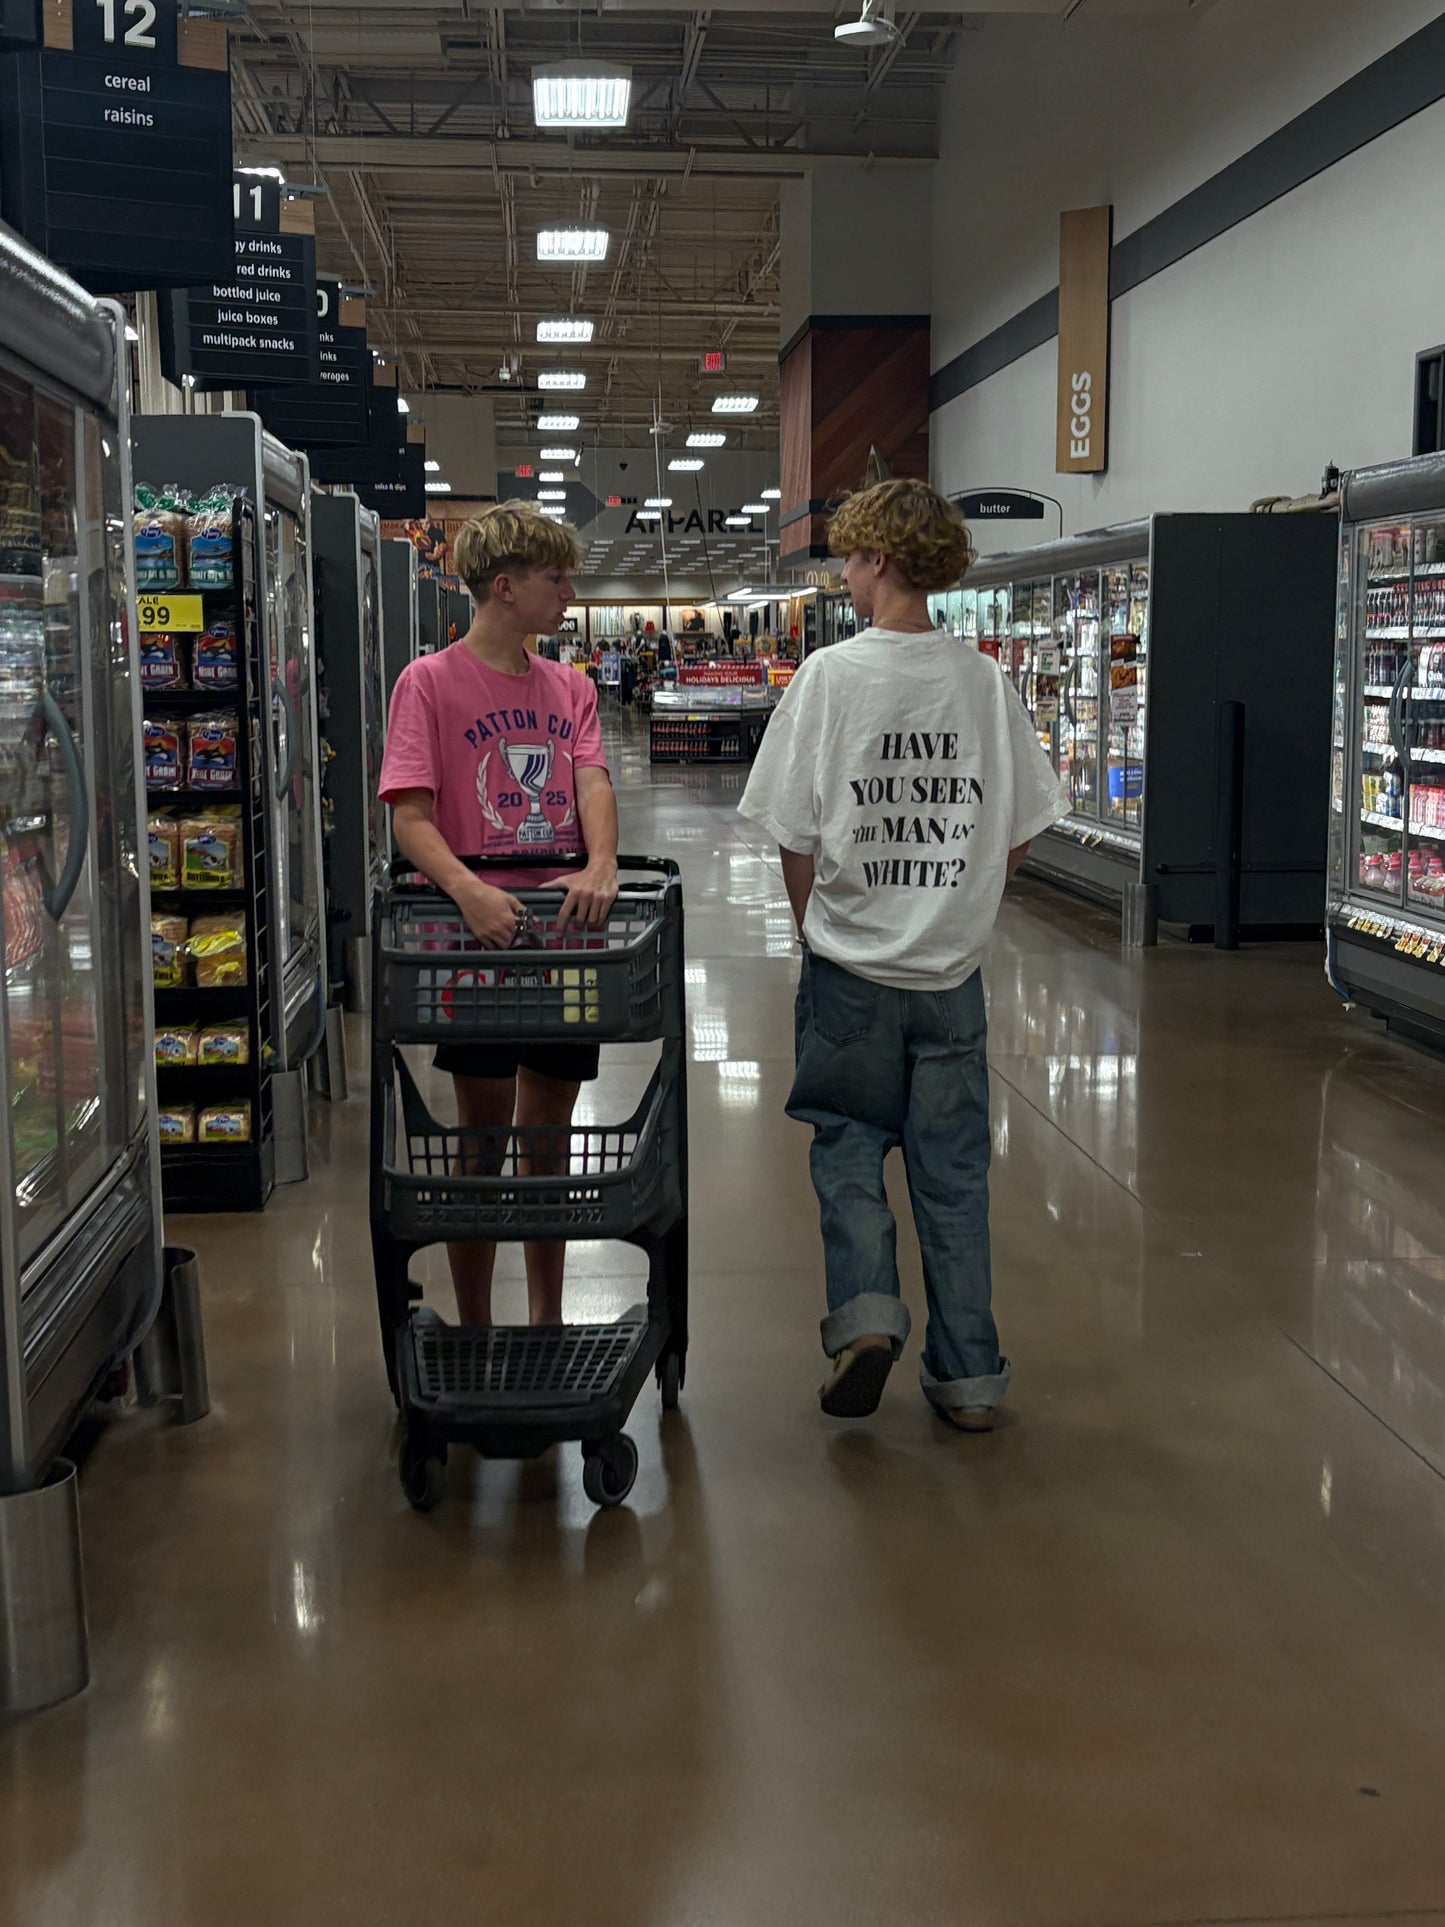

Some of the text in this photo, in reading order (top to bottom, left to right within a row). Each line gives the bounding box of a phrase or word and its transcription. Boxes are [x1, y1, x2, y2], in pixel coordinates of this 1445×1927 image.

[96, 0, 156, 48] 12
[104, 75, 151, 93] cereal
[104, 106, 154, 127] raisins
[233, 183, 262, 221] 11
[248, 240, 282, 254] drinks
[257, 264, 291, 279] drinks
[213, 285, 281, 303] bottled juice
[218, 308, 279, 326] juice boxes
[203, 332, 295, 350] multipack snacks
[1070, 371, 1092, 459] EGGS
[980, 503, 1011, 514] butter
[685, 675, 756, 684] HOLIDAYS DELICIOUS
[464, 709, 573, 749] PATTON CU
[880, 733, 958, 760] HAVE
[498, 790, 567, 808] 20 25
[849, 776, 985, 806] YOU SEEN
[852, 816, 975, 844] THE MAN IN
[863, 858, 966, 888] WHITE?
